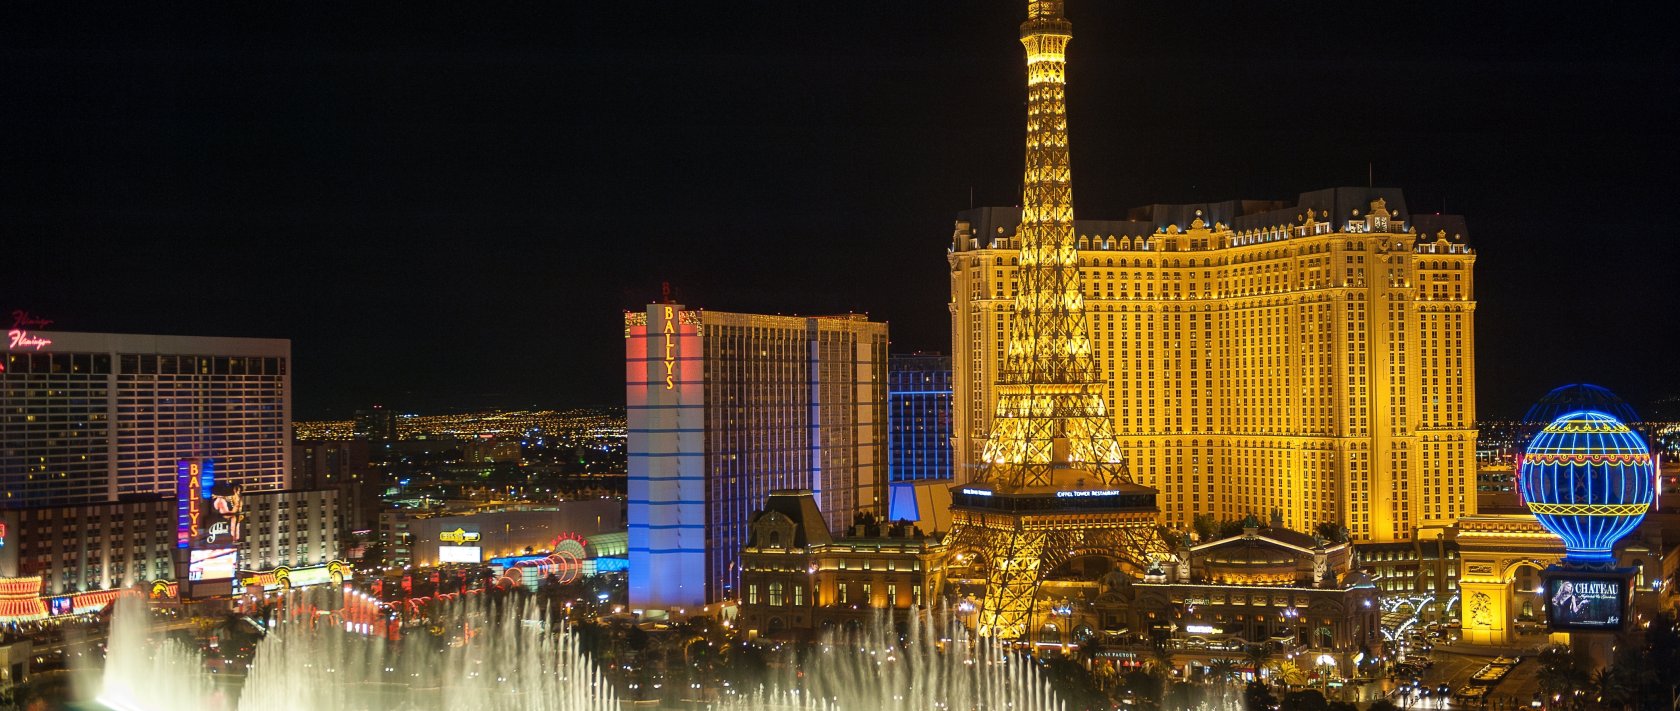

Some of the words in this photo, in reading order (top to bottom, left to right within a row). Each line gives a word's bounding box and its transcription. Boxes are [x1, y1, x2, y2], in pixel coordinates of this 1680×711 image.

[8, 330, 52, 350] Flamingo
[664, 306, 675, 390] BALLYS
[189, 464, 200, 537] BALLYS
[1575, 583, 1619, 595] CHATEAU
